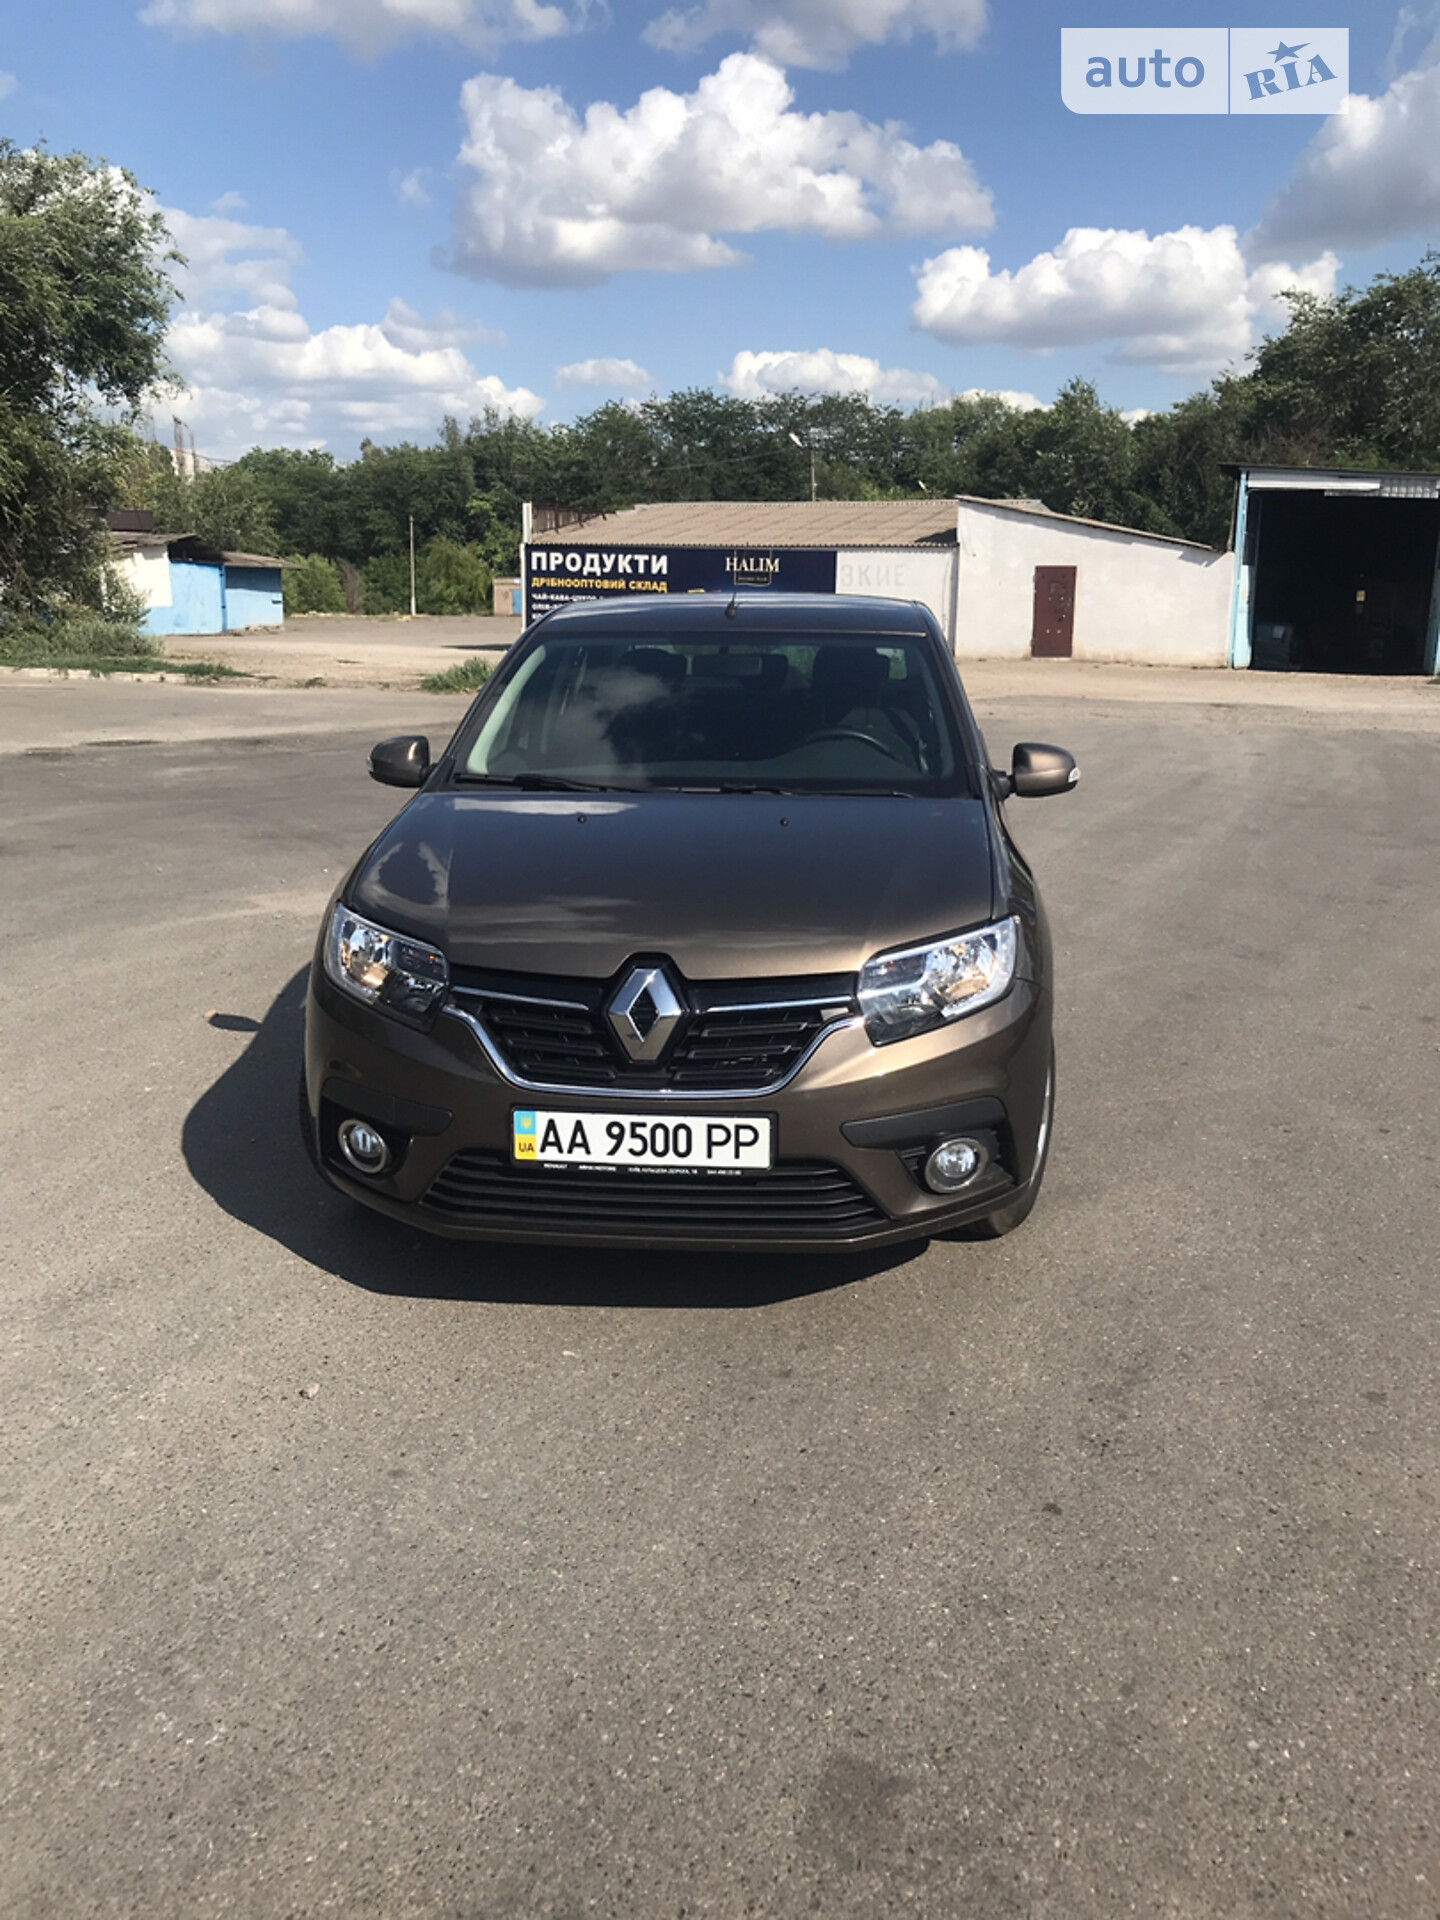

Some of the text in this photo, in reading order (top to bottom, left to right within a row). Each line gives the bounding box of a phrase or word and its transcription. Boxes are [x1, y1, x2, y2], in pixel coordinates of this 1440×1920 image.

[530, 551, 668, 576] ПРОДУКТИ
[725, 556, 780, 573] HALIM
[531, 577, 668, 594] ДРІБНООПТОВИЙ СКЛАД
[518, 1142, 535, 1153] UA
[539, 1118, 760, 1160] AA 9500 PP
